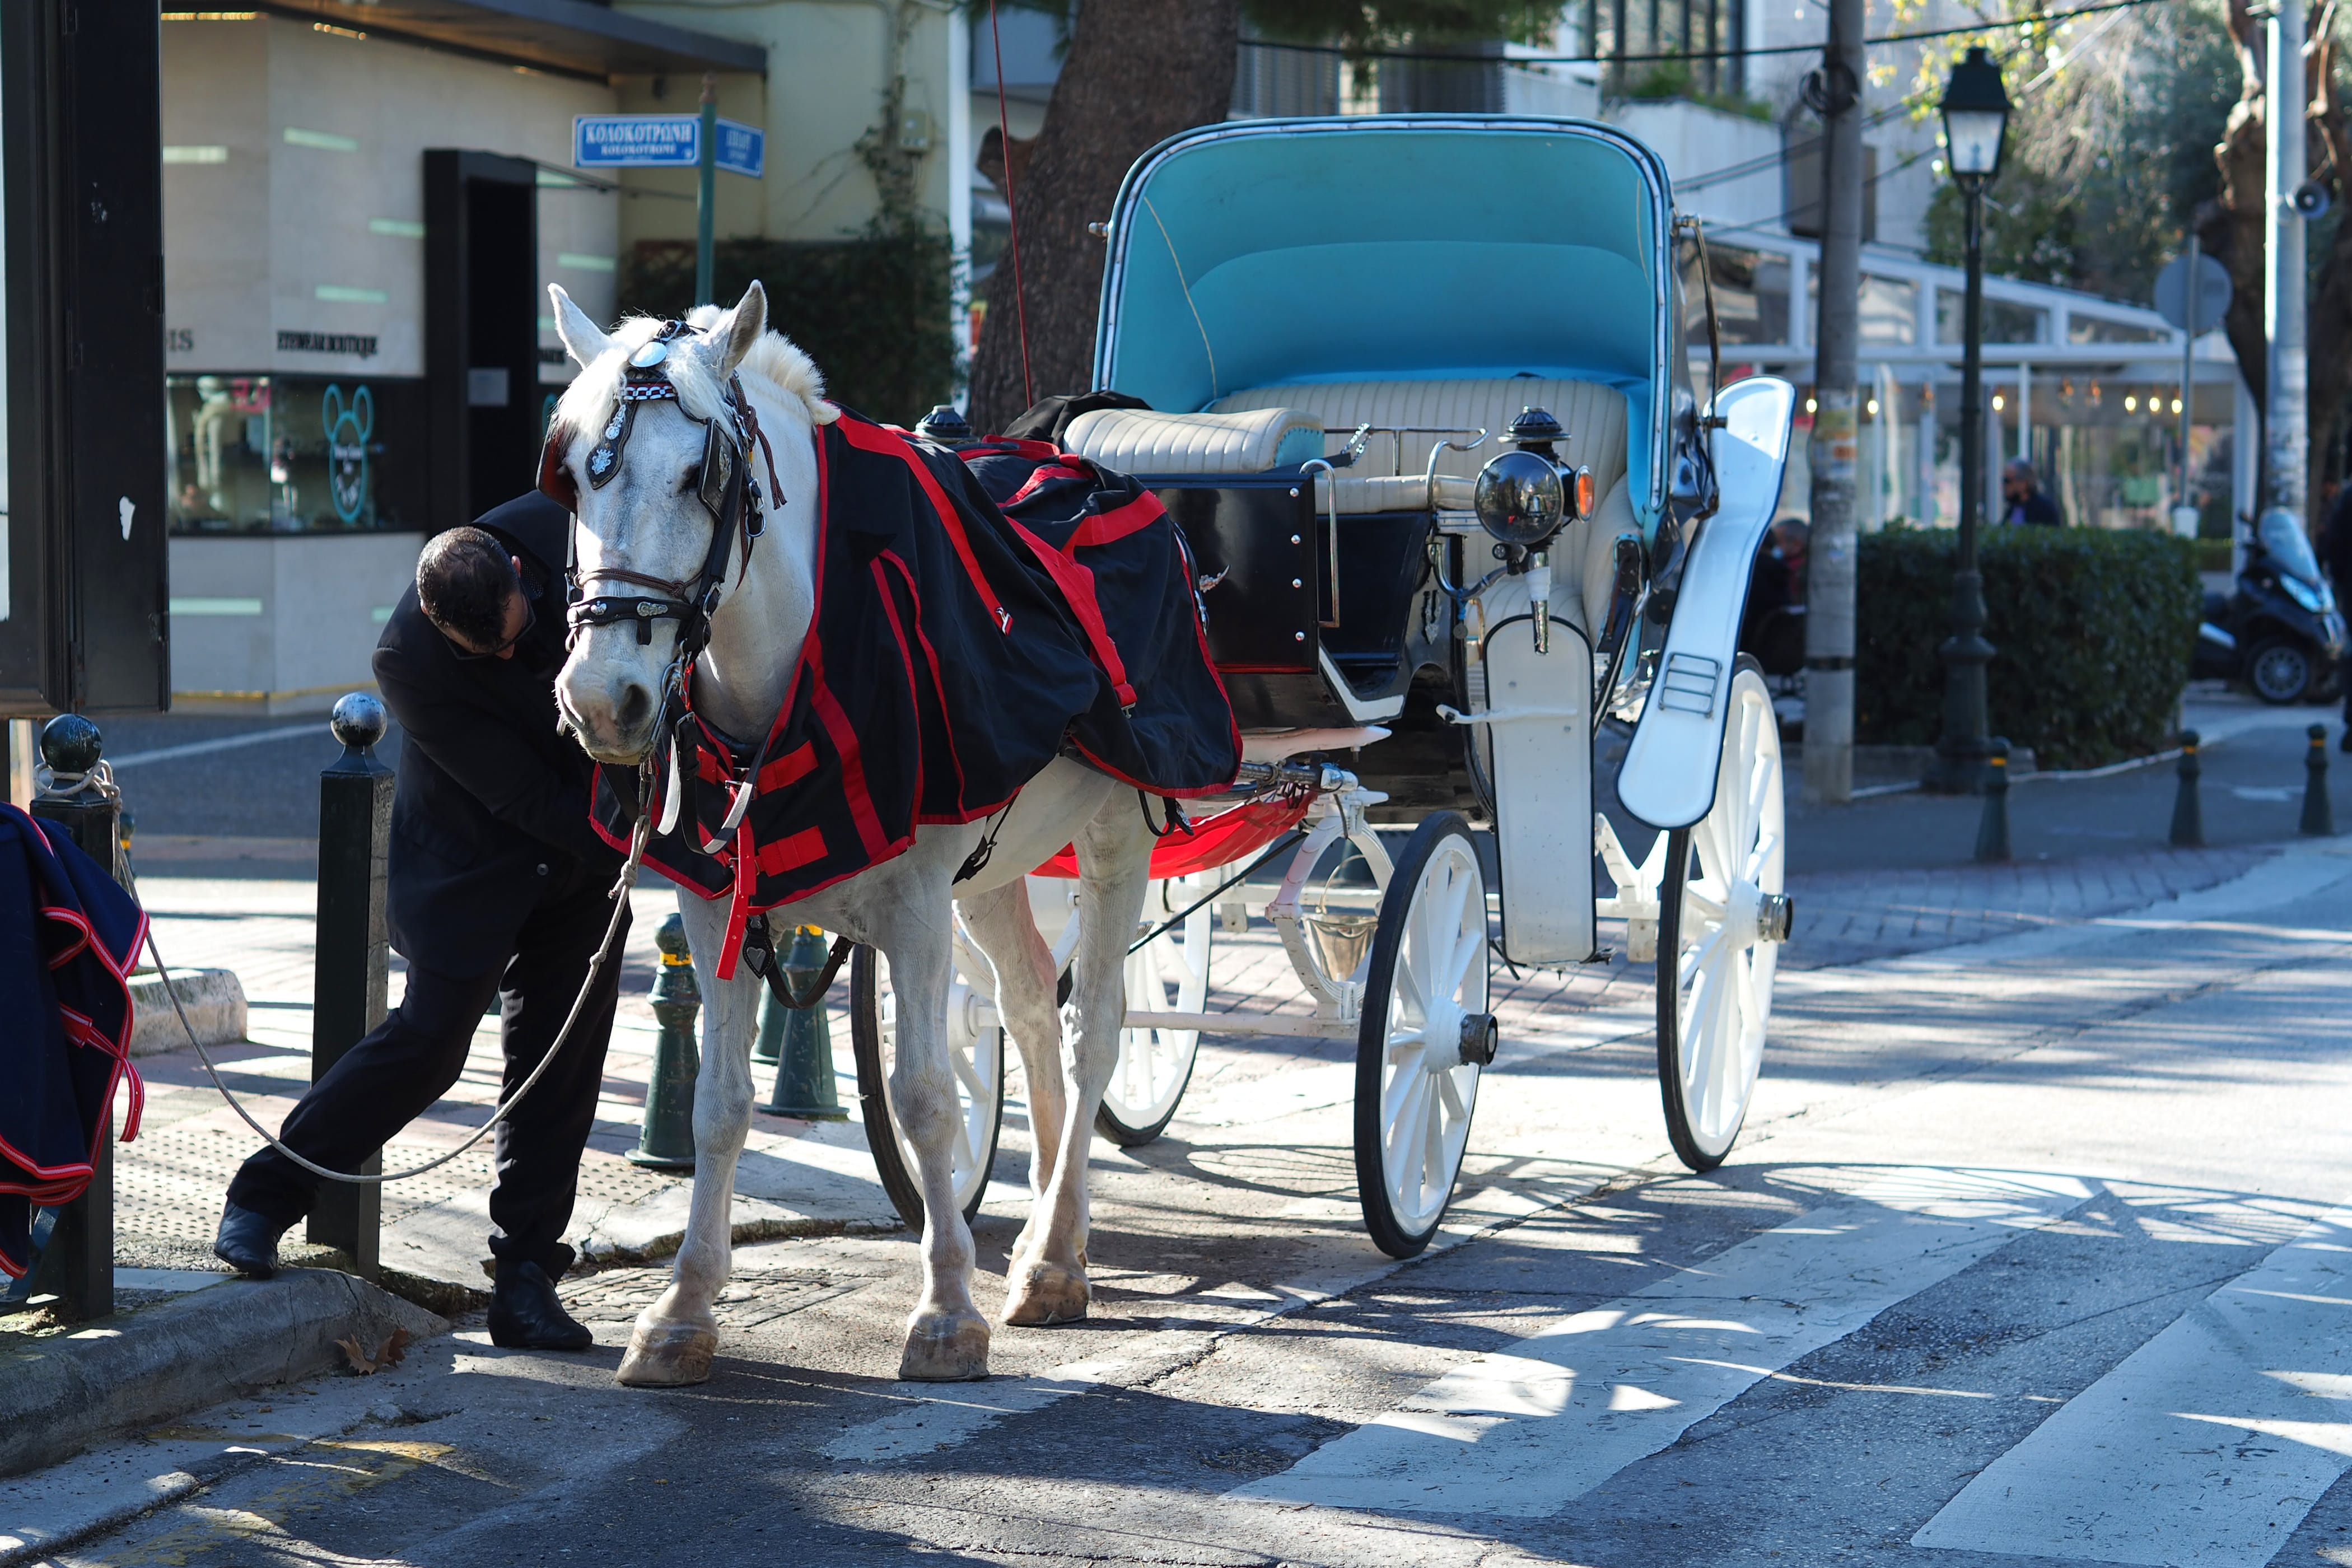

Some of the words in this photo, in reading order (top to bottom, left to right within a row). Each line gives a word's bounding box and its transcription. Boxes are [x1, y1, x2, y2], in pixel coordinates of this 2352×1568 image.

[585, 124, 692, 143] ΚΟΛΟΚΟΤΡΩΝΗ
[601, 144, 676, 156] KOLOKOTRONI
[166, 329, 194, 351] IS
